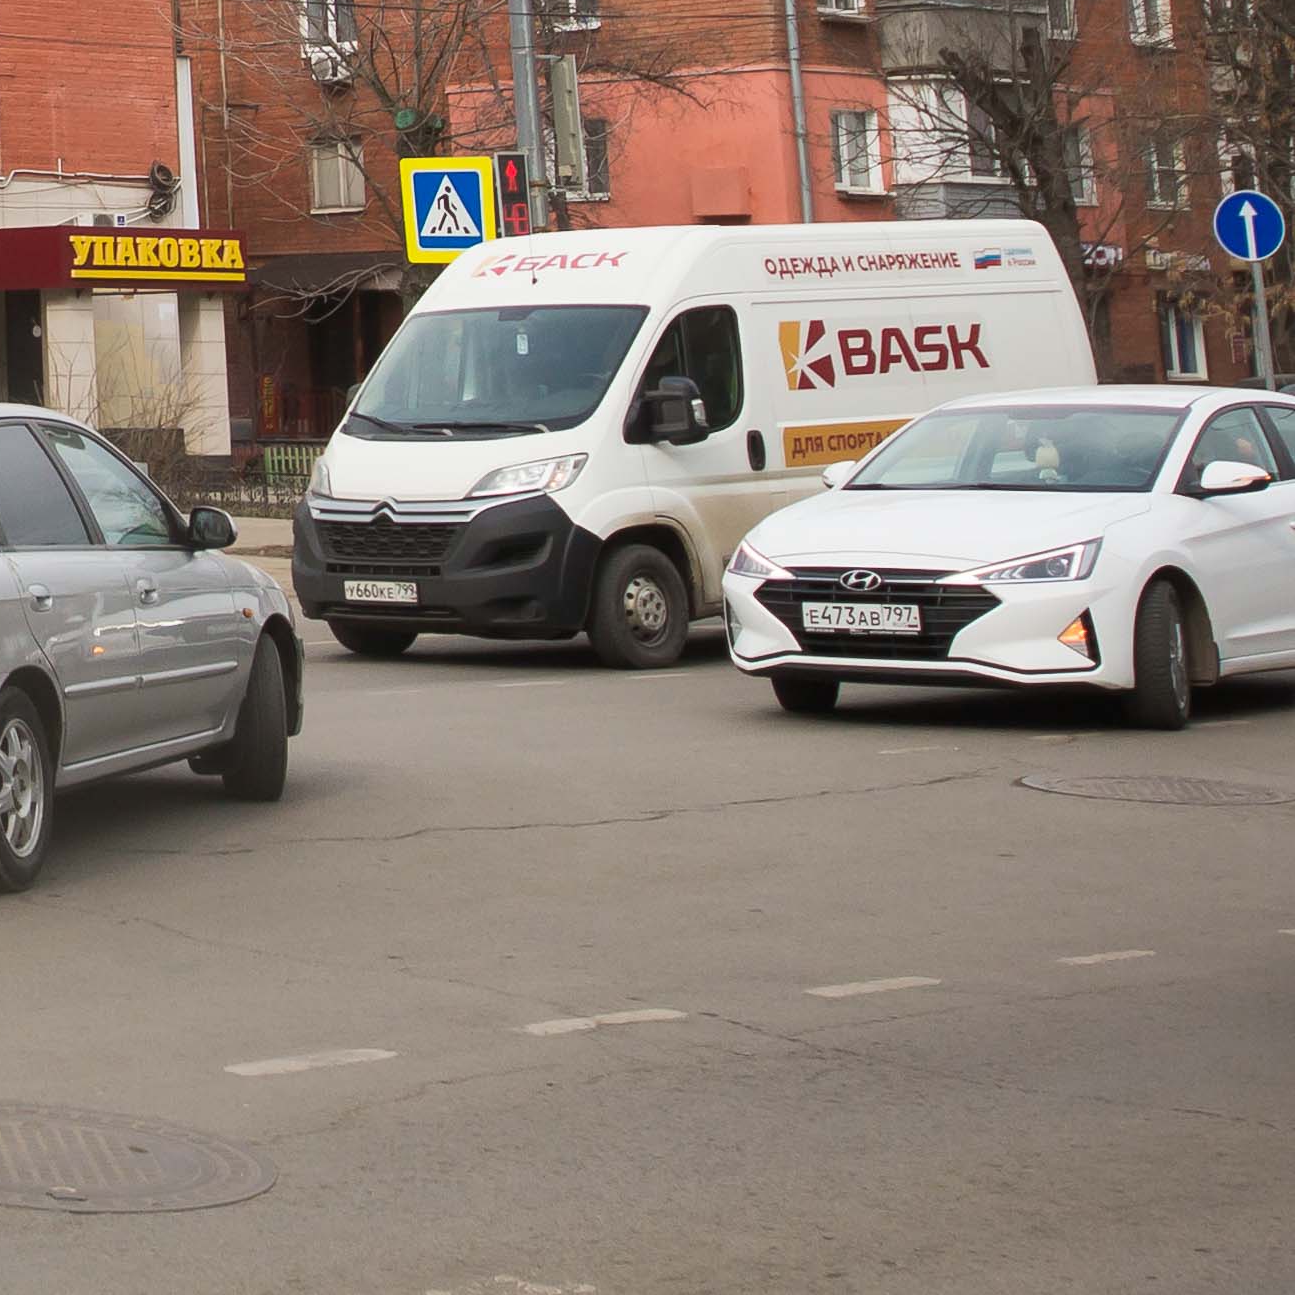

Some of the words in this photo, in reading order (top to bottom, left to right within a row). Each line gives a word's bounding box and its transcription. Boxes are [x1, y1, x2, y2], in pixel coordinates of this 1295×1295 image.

[69, 235, 245, 269] УПАКОВКА
[764, 256, 841, 279] ОДЕЖДА
[845, 255, 854, 273] И
[859, 251, 961, 272] СНАРЯЖЕНИЕ
[838, 323, 991, 375] BASK
[792, 434, 824, 459] ДЛЯ
[883, 606, 912, 622] 797
